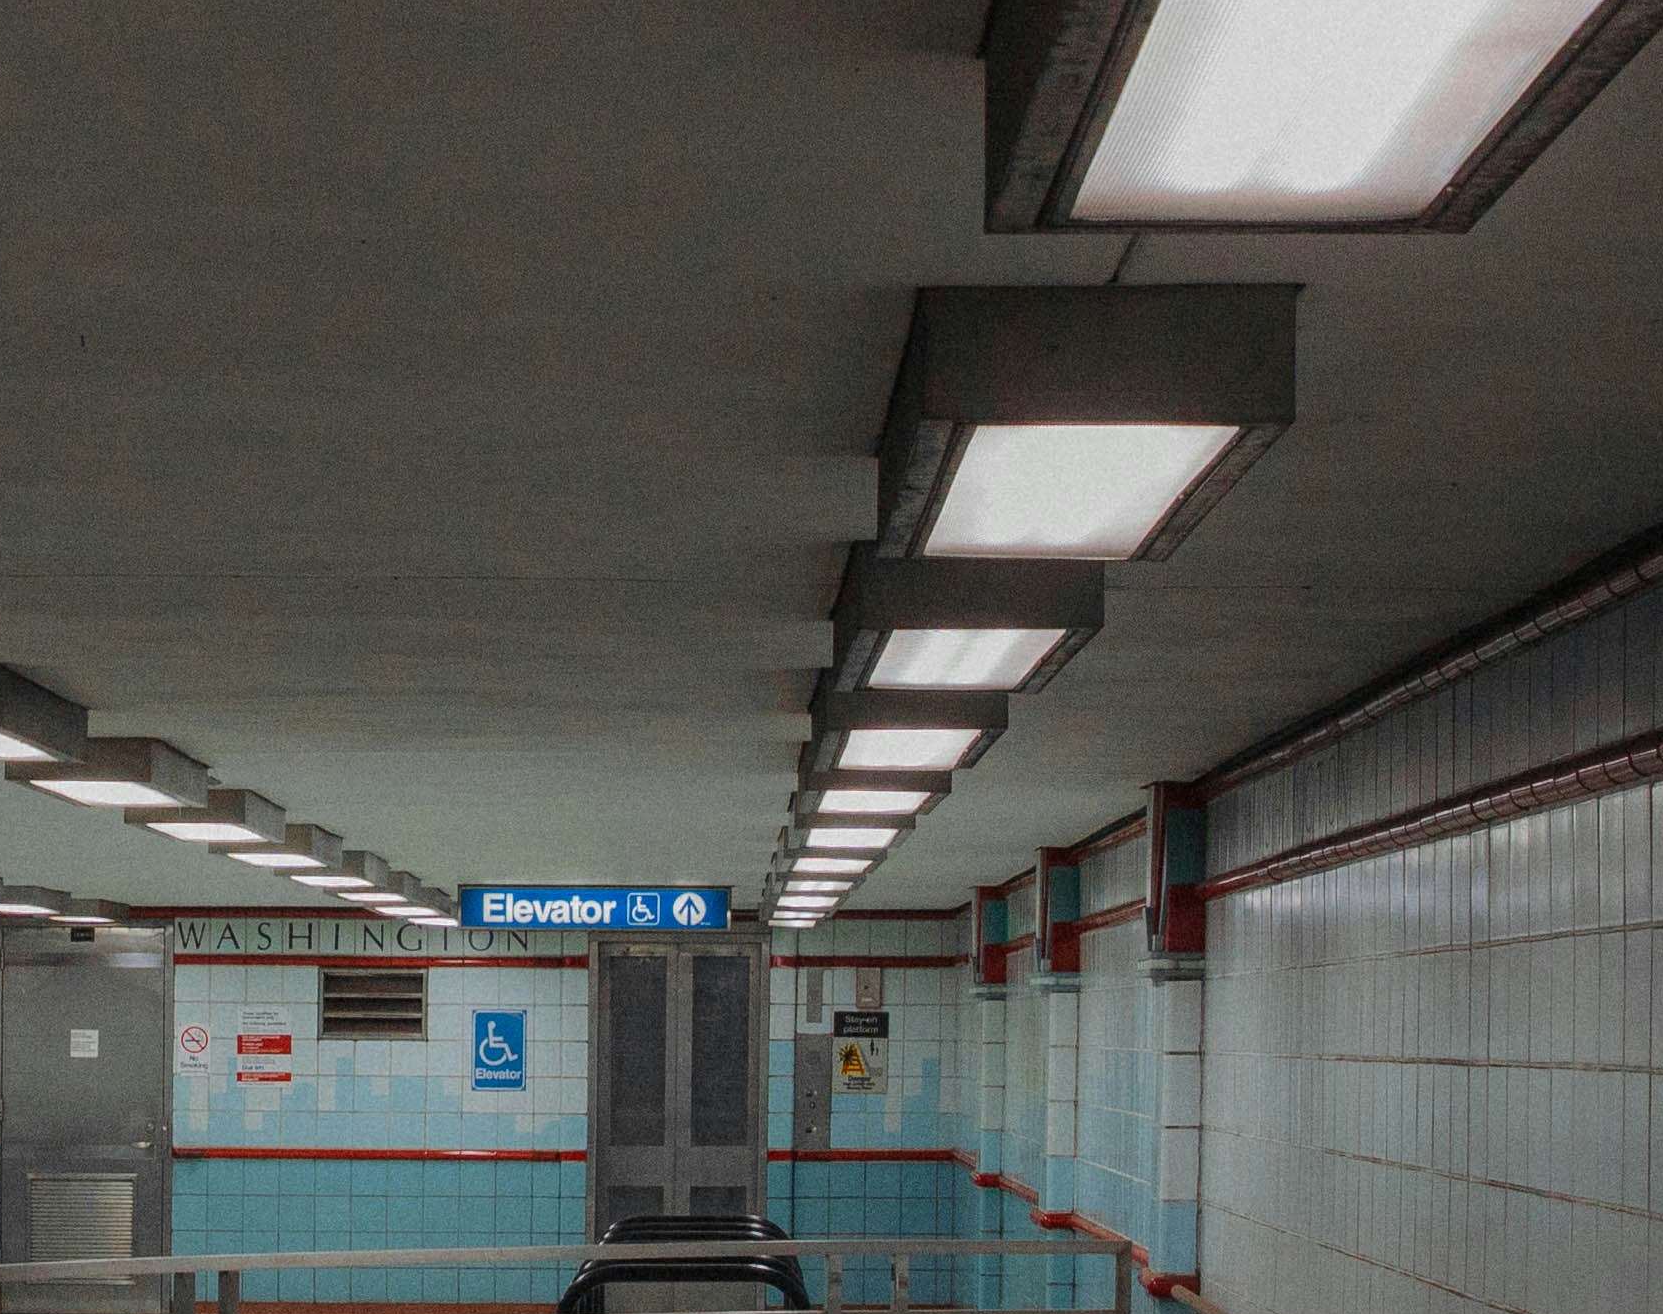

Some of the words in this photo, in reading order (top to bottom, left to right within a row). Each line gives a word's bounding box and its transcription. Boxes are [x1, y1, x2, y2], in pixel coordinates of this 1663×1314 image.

[482, 892, 618, 925] Elevator
[176, 921, 531, 954] WASHINGTON
[843, 1025, 879, 1035] platform
[180, 1062, 209, 1070] Smoking
[475, 1067, 522, 1080] Elevator
